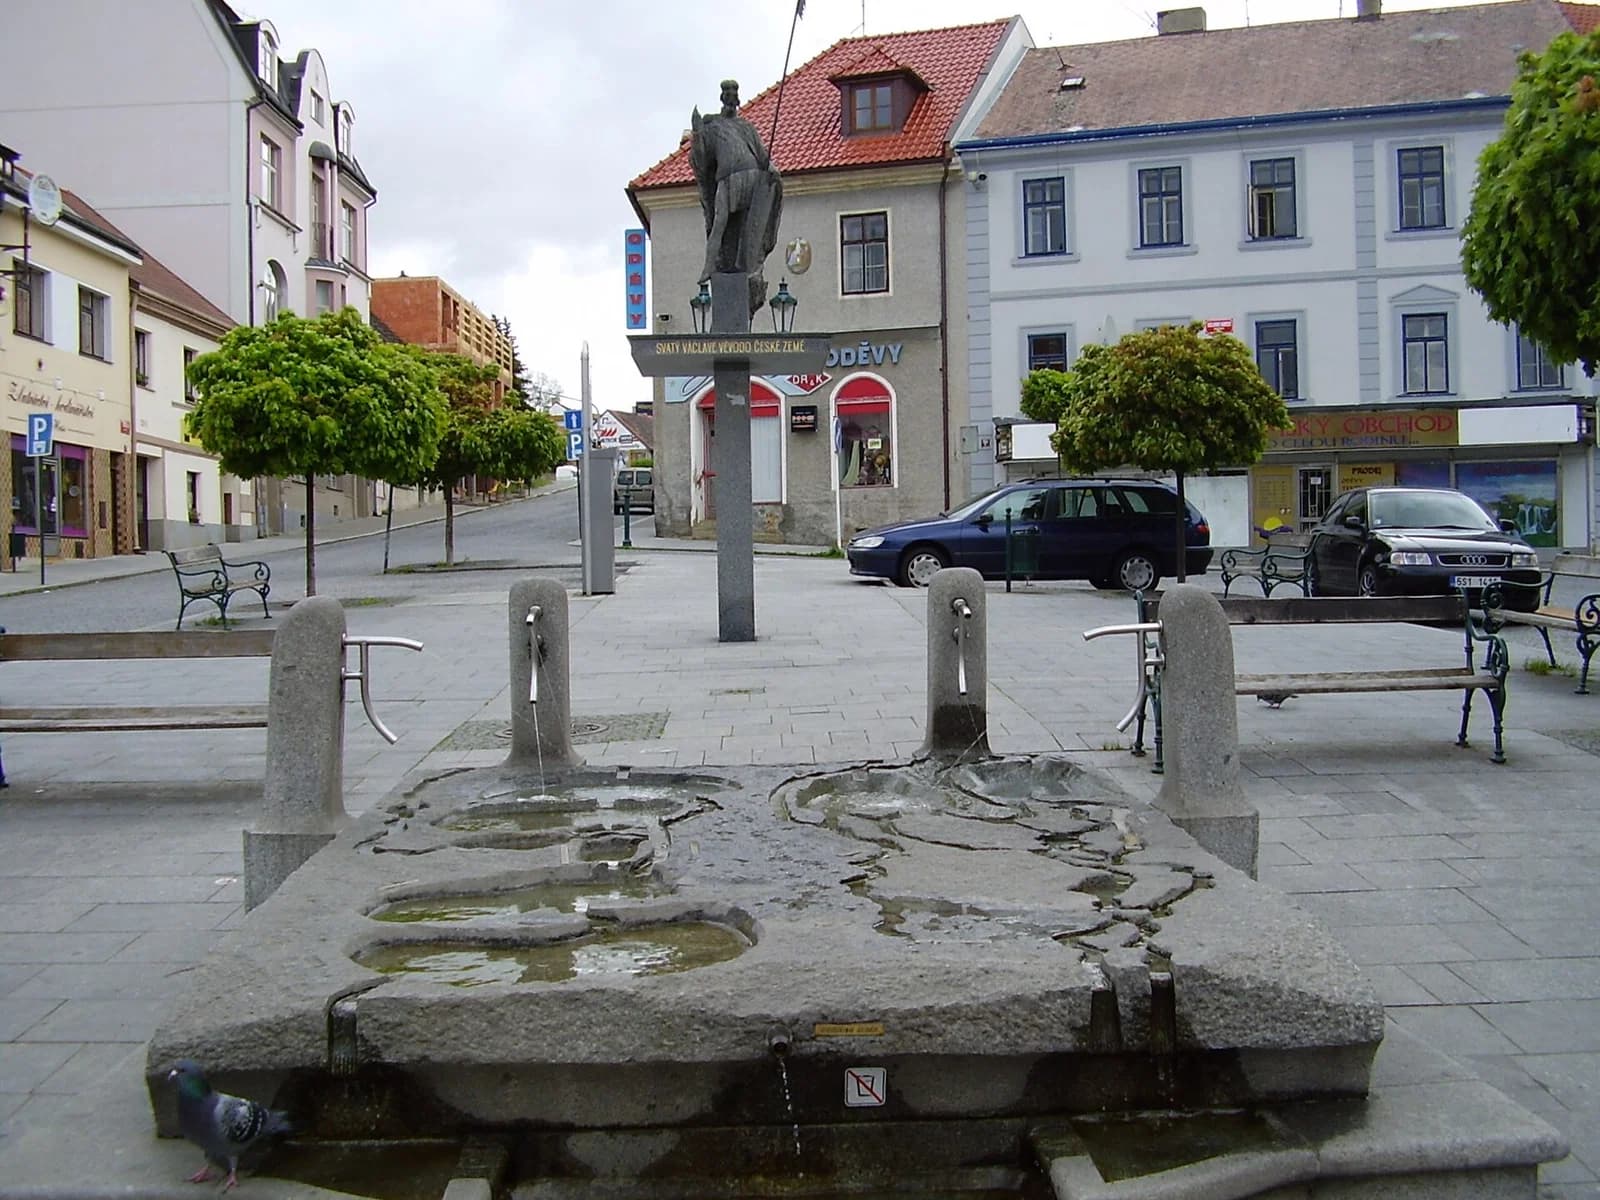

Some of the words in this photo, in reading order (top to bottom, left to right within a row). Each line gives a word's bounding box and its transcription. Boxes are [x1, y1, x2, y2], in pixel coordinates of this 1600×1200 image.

[34, 417, 47, 440] P
[1344, 414, 1453, 434] OBCHOD
[571, 434, 581, 450] P
